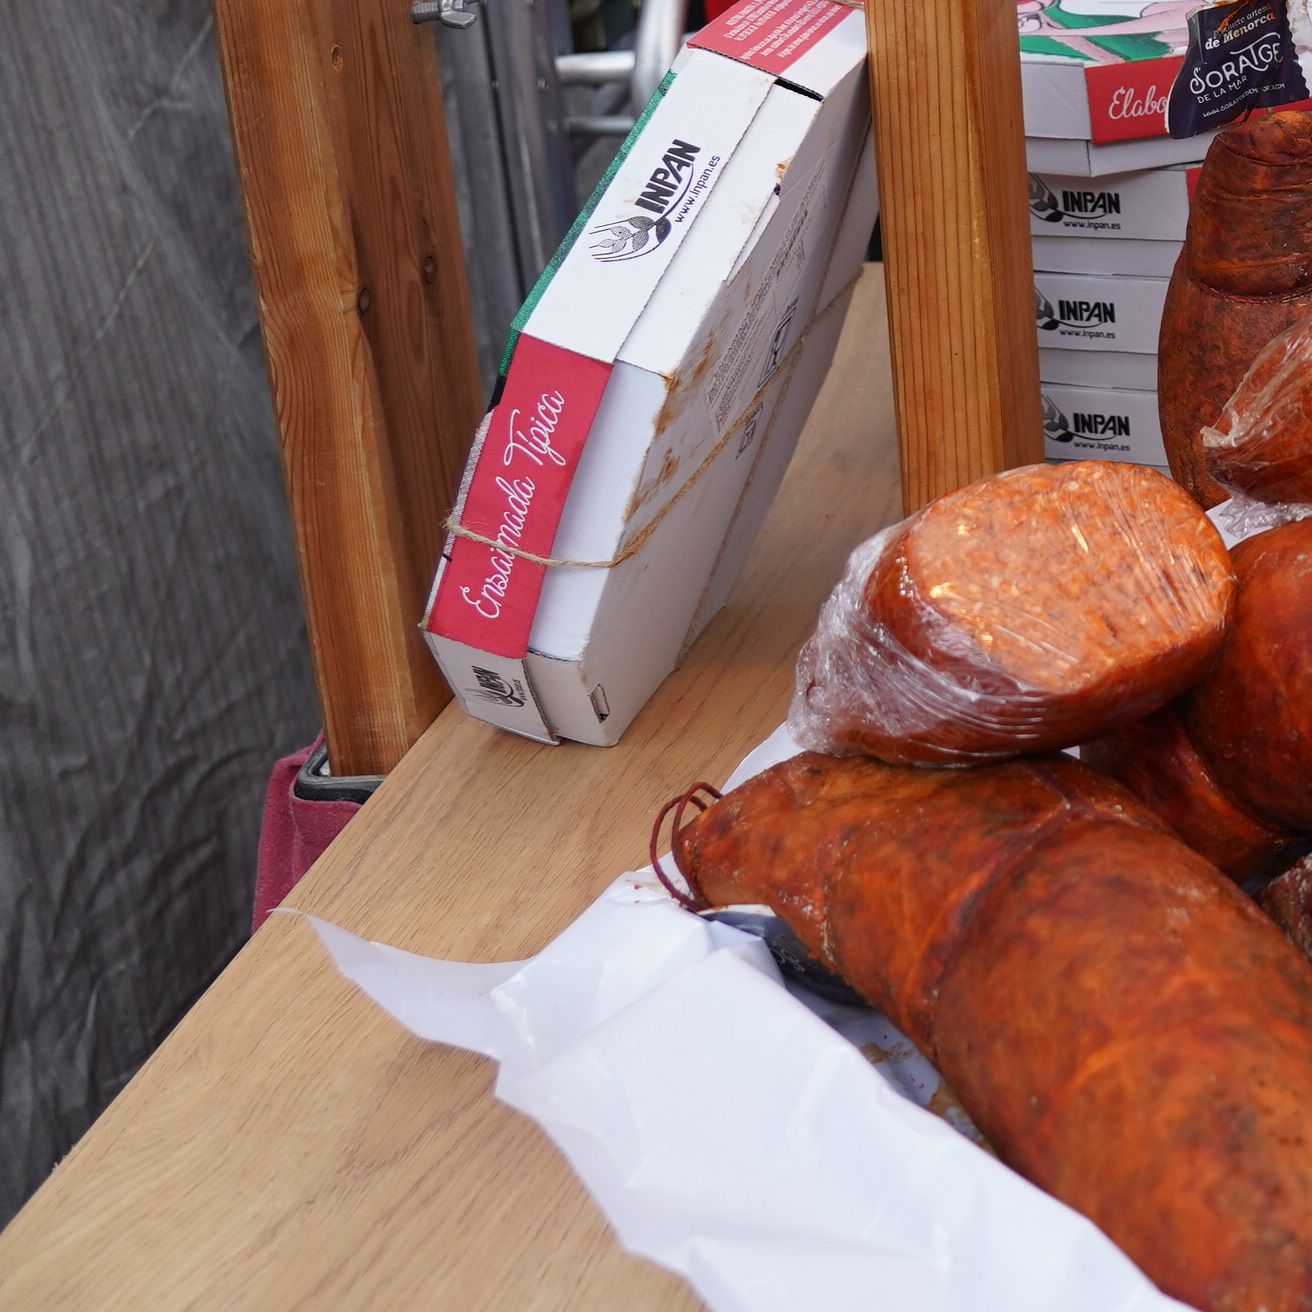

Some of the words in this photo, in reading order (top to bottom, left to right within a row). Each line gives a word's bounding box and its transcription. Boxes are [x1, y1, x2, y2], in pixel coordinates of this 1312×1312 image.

[1205, 35, 1221, 51] de
[1222, 11, 1276, 44] Menorca
[1197, 94, 1212, 104] DE
[1213, 88, 1227, 99] LA
[1229, 75, 1248, 91] MAR
[634, 138, 702, 214] INPAN
[674, 155, 721, 223] www.inpan.es
[1062, 190, 1121, 214] INPAN
[1063, 220, 1121, 230] www.inpan.es
[1058, 299, 1116, 323] INPAN
[1059, 329, 1116, 339] www.inpan.es
[1073, 412, 1131, 436] INPAN
[1074, 441, 1131, 452] www.inpan.es
[459, 475, 536, 619] Ensaimada
